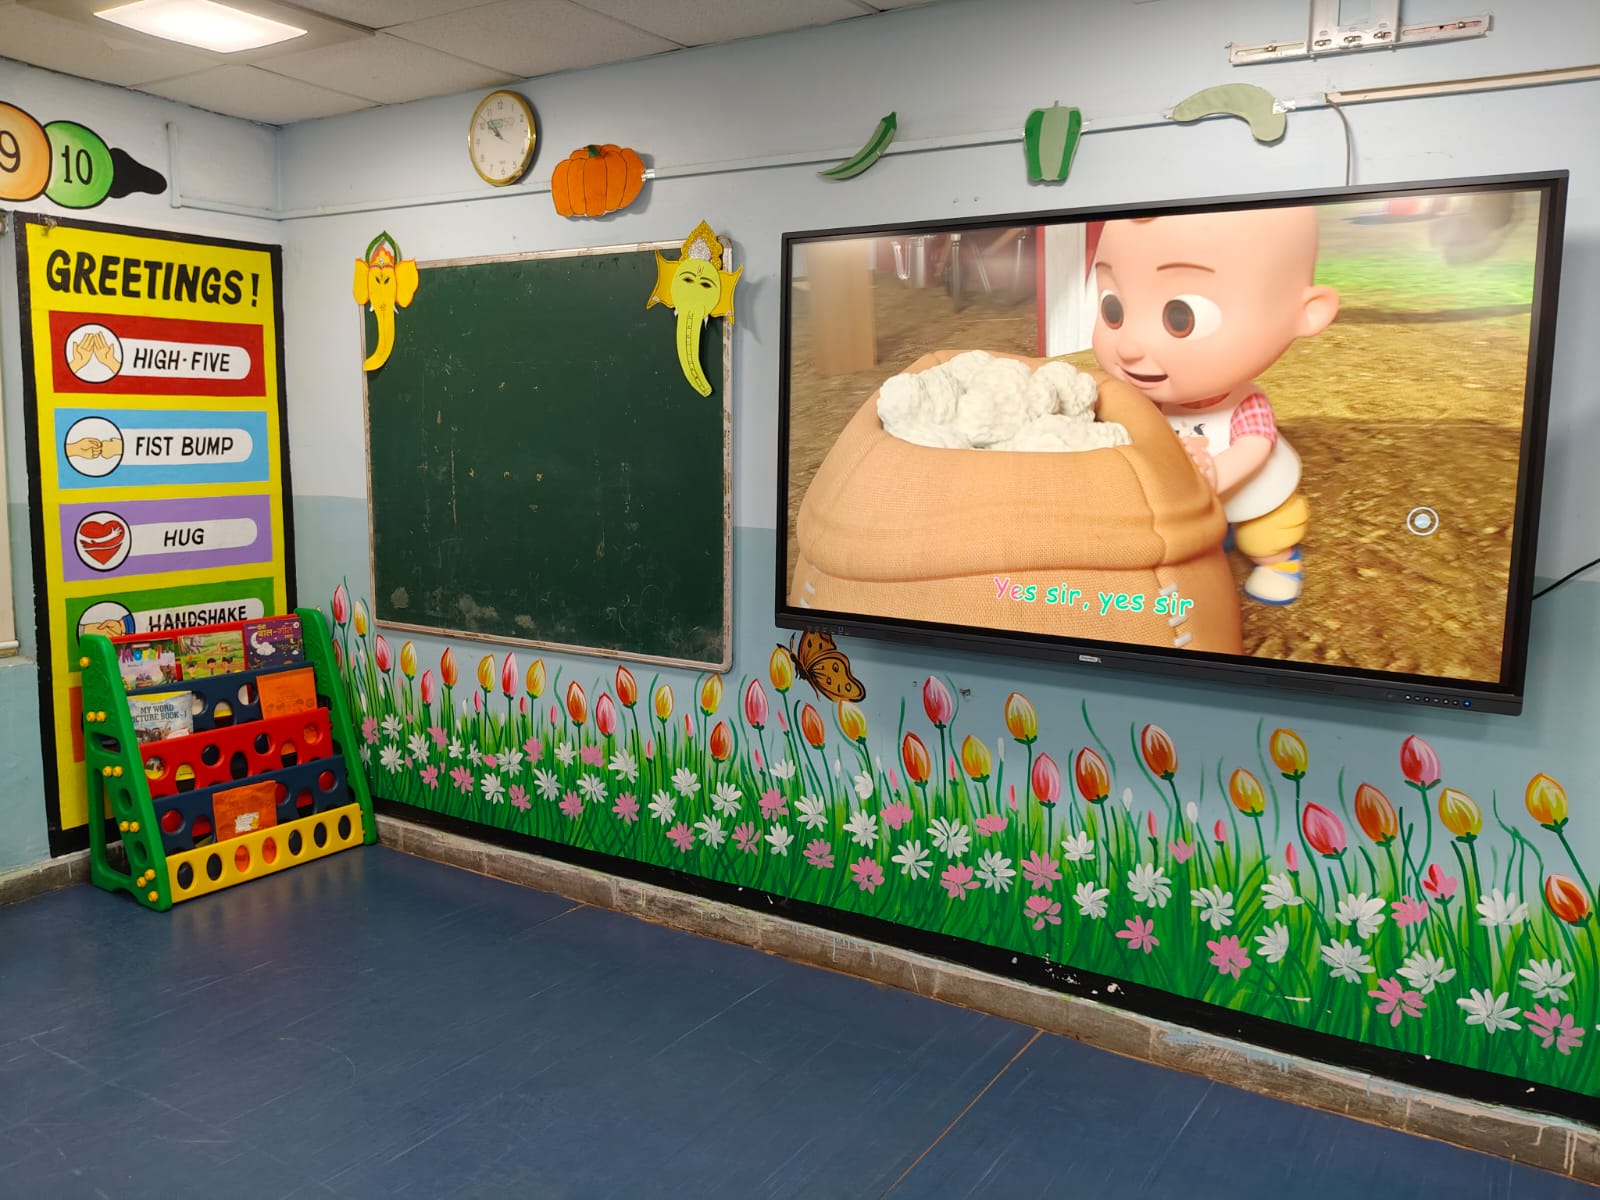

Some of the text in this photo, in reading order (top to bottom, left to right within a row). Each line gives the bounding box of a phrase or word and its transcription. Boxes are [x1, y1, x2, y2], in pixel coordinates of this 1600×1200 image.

[0, 130, 21, 173] 9
[61, 145, 93, 185] 10
[133, 348, 230, 373] HIGH-FIVE
[135, 436, 233, 457] FIST BUMP
[164, 528, 204, 547] HUG
[993, 577, 1194, 616] Yes sir, yes sir
[149, 605, 248, 632] HANDSHAKE
[132, 713, 160, 723] ICTURE
[140, 703, 174, 714] MY WORD
